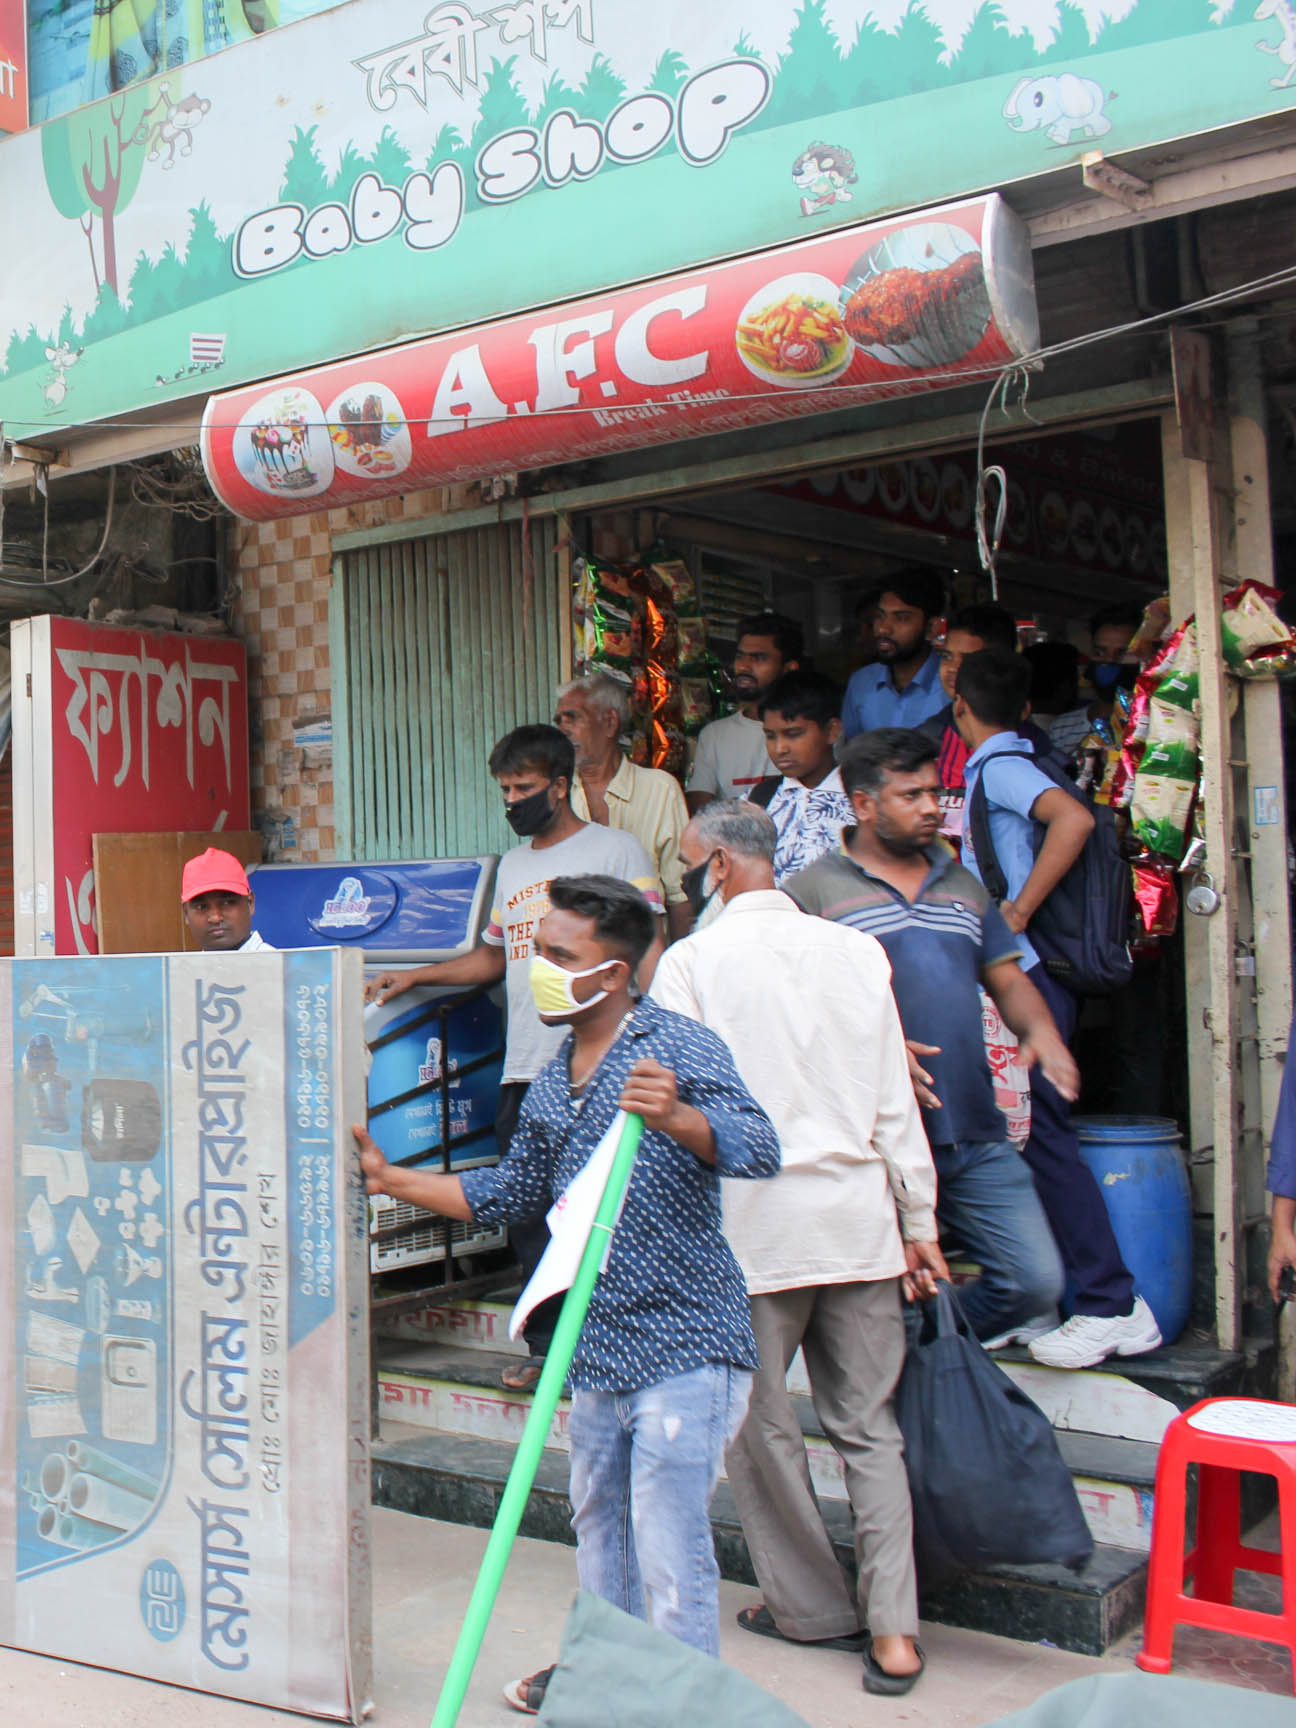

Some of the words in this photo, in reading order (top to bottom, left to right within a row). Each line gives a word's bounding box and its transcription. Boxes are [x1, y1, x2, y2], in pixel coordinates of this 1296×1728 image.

[352, 0, 494, 112] বেবী
[232, 158, 464, 281] Baby
[592, 392, 668, 427] Break
[665, 385, 731, 412] Time
[54, 636, 240, 794] ফ্যাশন
[506, 879, 553, 910] MISTE
[507, 920, 534, 943] THE
[181, 978, 253, 1304] এন্টারপ্রাইজ
[179, 1309, 251, 1491] সেলিম
[186, 1496, 251, 1672] মেসার্স
